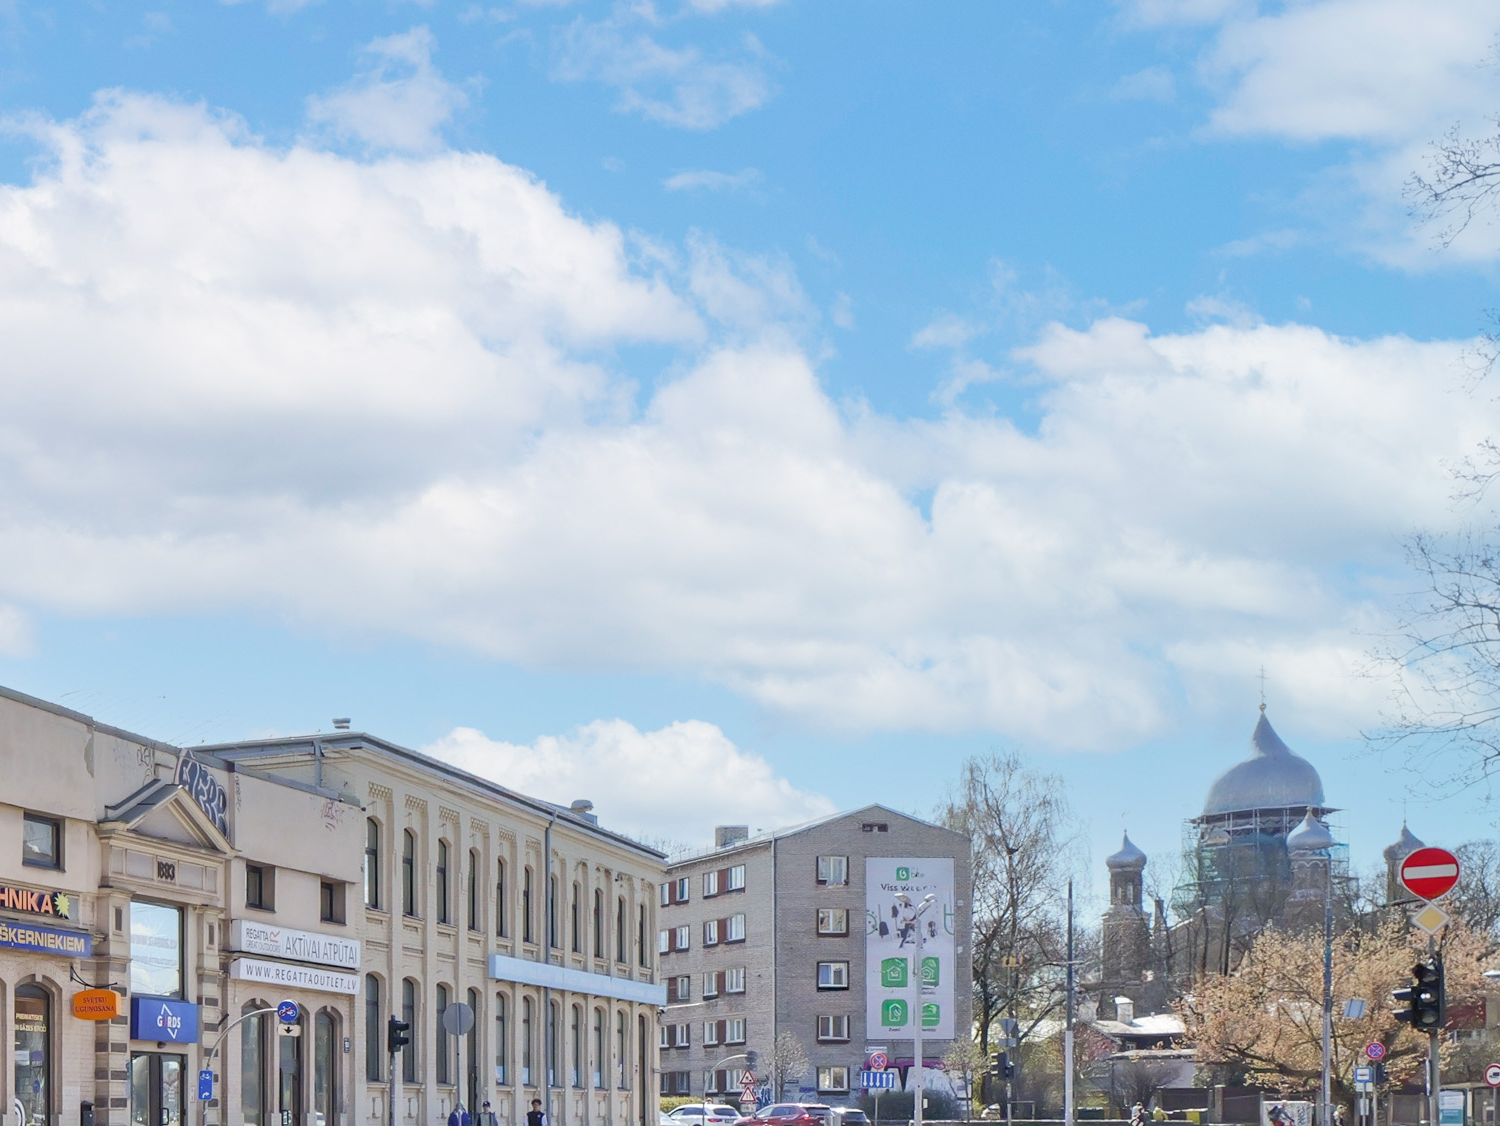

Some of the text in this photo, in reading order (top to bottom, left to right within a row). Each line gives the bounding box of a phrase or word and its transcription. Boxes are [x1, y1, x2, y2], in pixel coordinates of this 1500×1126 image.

[245, 927, 269, 941] REGATTA
[285, 934, 358, 965] AKTĪVAI ATPŪTAI
[245, 964, 357, 990] WWW.REGATTAOUTLET.LV
